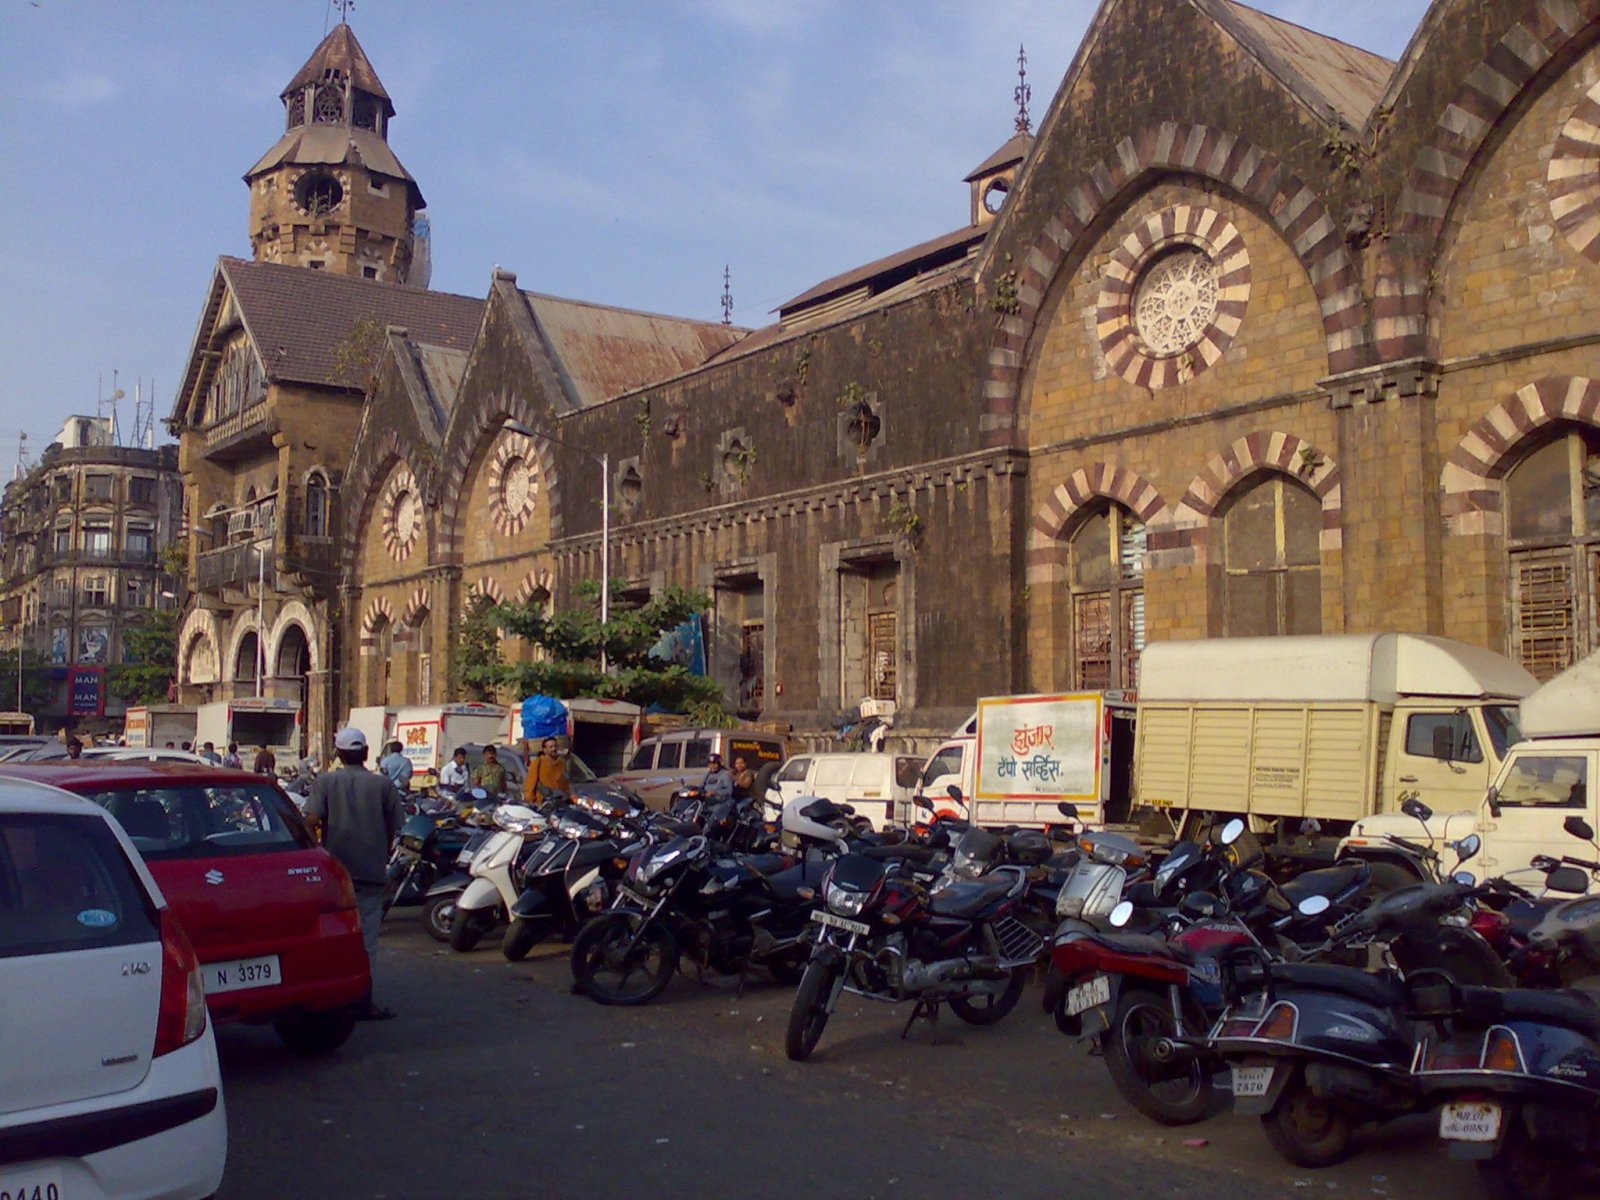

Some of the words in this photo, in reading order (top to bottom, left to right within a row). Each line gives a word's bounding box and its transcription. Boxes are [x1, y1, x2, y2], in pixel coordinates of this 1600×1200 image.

[74, 676, 98, 684] MAN
[74, 693, 98, 701] MAN
[1010, 723, 1055, 756] झुंजार
[287, 866, 319, 876] SWIFT
[217, 969, 228, 986] N
[238, 964, 272, 982] 3379
[1236, 1082, 1264, 1092] 7570
